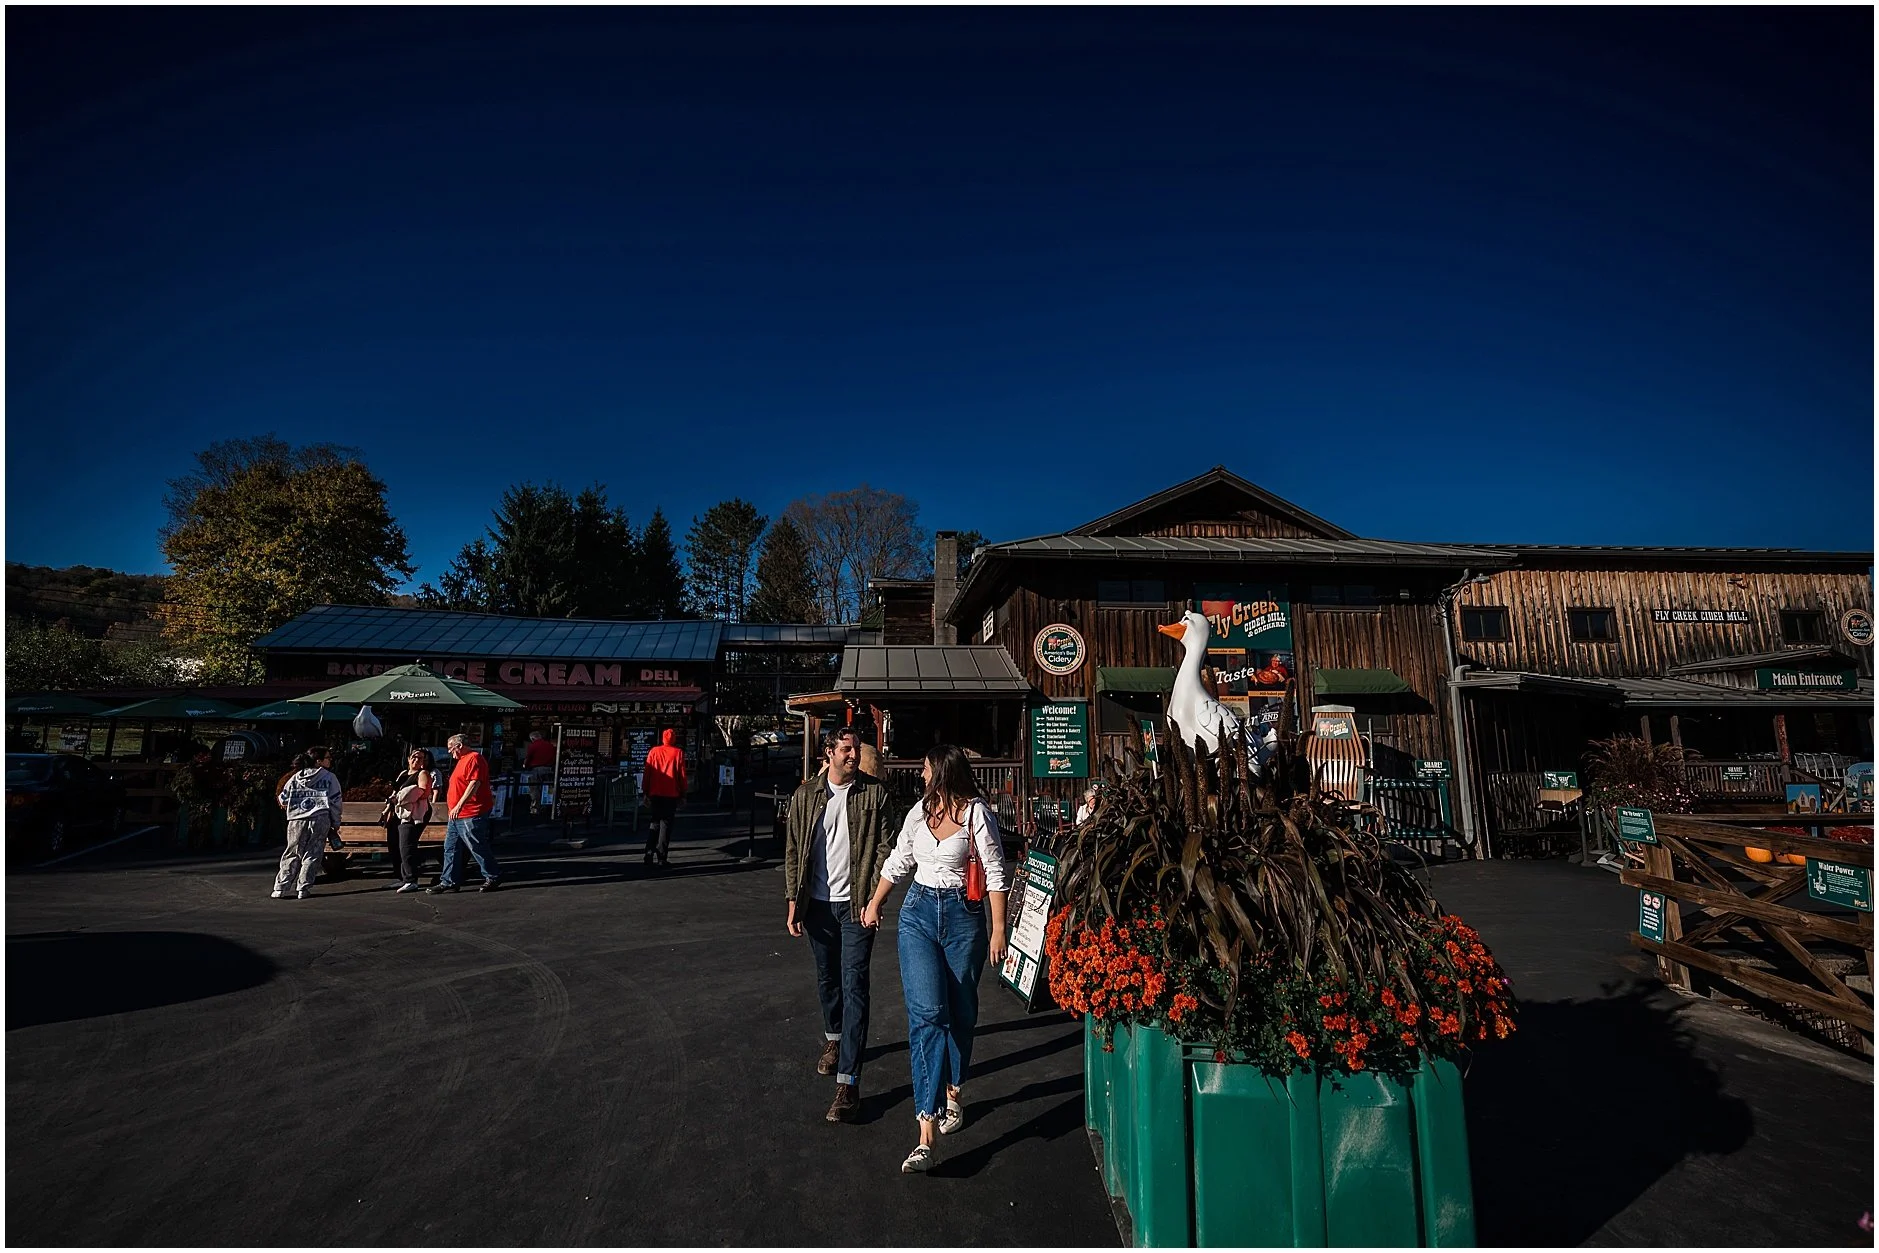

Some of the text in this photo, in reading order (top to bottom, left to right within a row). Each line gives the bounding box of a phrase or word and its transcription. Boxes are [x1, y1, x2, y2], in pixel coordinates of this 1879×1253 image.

[1231, 590, 1280, 627] Creek
[1655, 610, 1748, 621] FLY CREEK CIDER MILL
[1244, 612, 1286, 633] CIDER MILL
[1048, 655, 1072, 664] Cidery
[432, 660, 486, 684] ICE
[498, 660, 622, 686] CREAM
[640, 668, 680, 681] DELI
[1216, 667, 1255, 684] Taste
[1772, 672, 1843, 686] Main Entrance
[1042, 705, 1077, 715] Welcome!
[1262, 713, 1278, 722] AND
[1028, 856, 1055, 875] DISCOVER OU
[1818, 861, 1855, 876] Water Power
